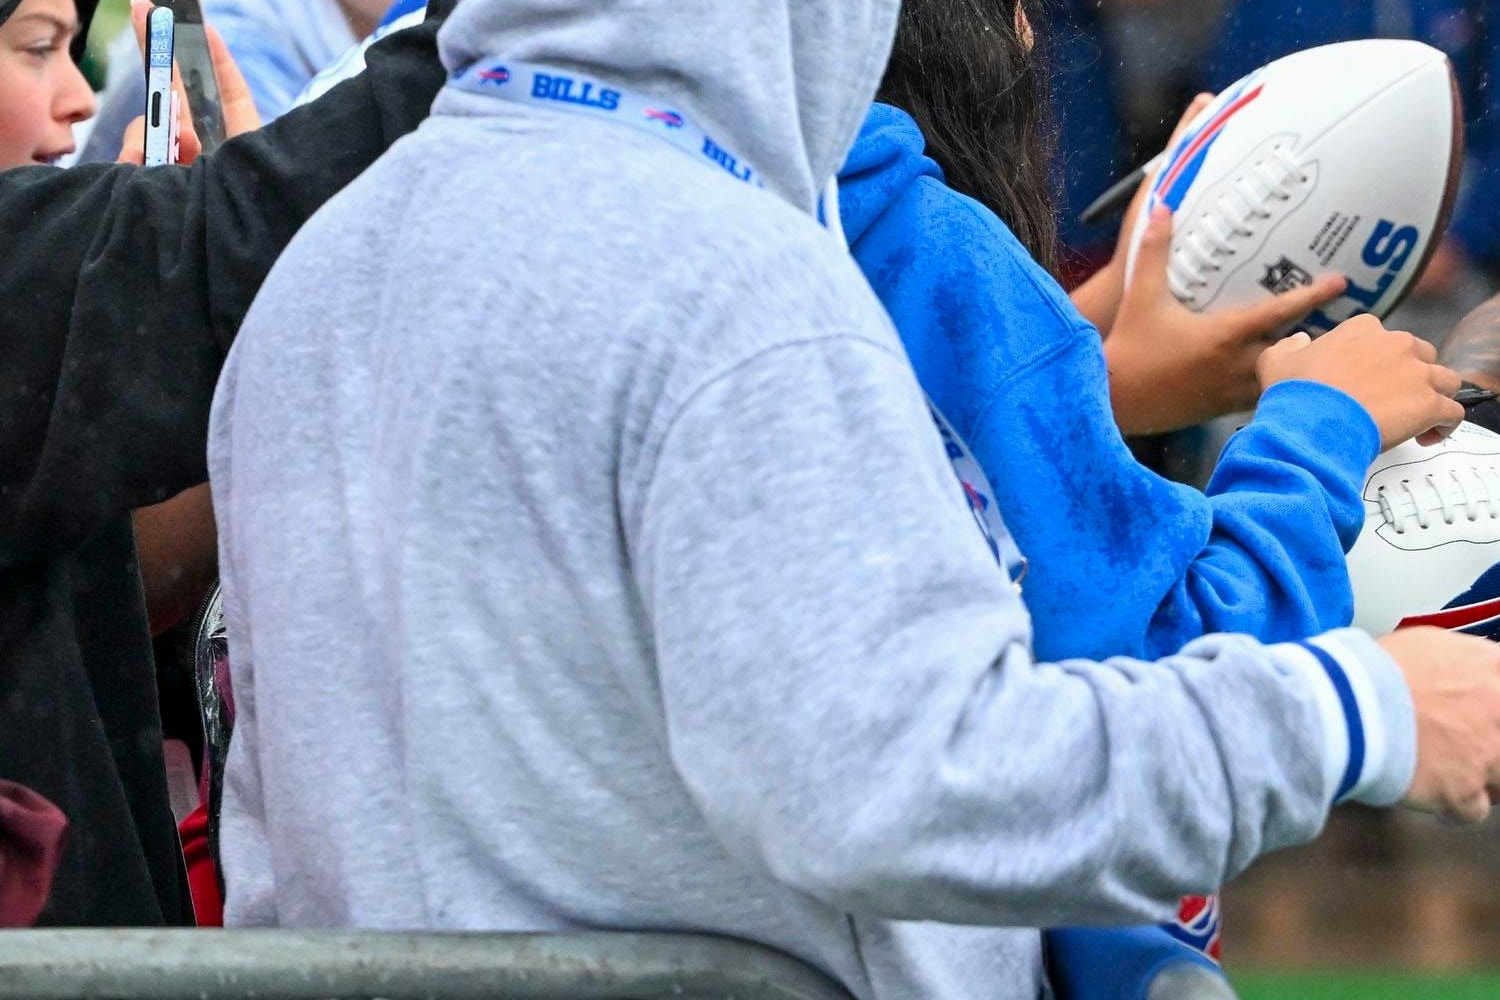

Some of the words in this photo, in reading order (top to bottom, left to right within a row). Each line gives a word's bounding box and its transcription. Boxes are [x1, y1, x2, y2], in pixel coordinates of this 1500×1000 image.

[531, 72, 622, 111] BILLS
[702, 135, 764, 187] BILL
[1288, 219, 1419, 336] LLS
